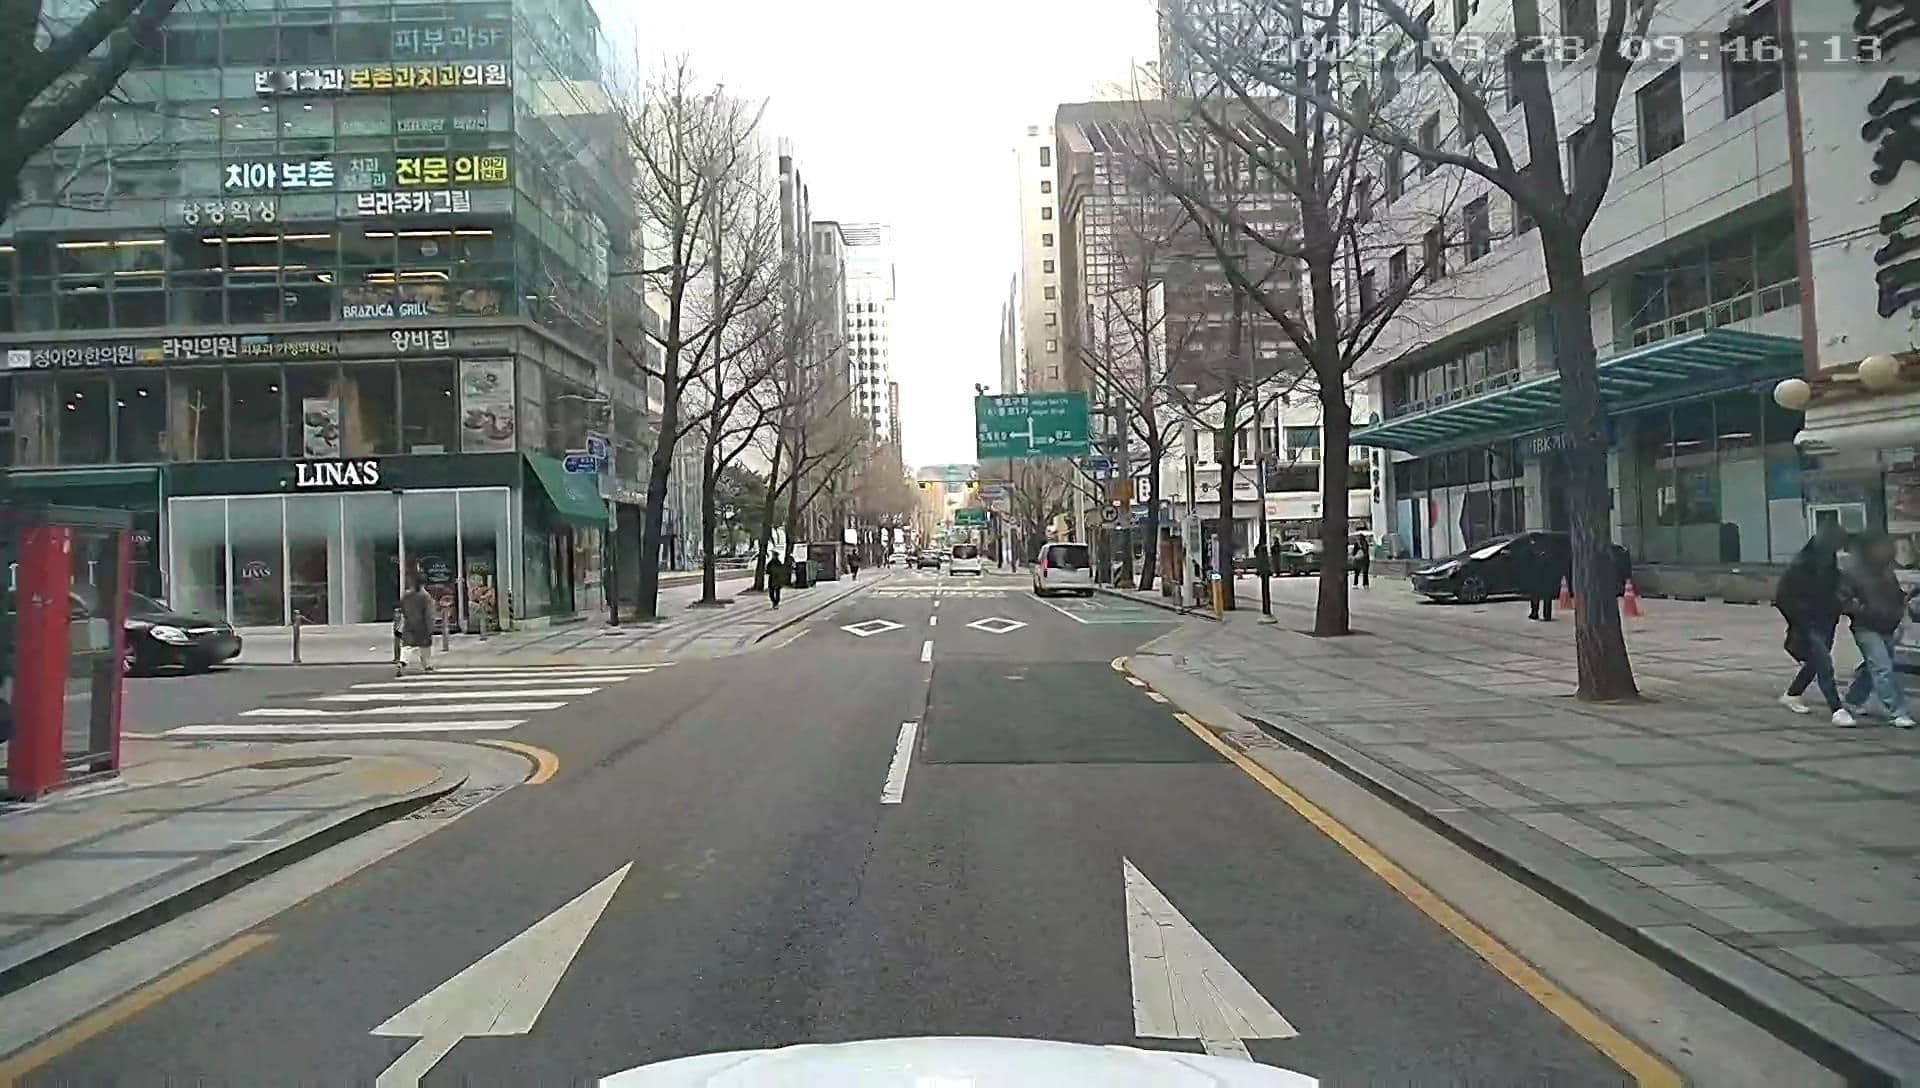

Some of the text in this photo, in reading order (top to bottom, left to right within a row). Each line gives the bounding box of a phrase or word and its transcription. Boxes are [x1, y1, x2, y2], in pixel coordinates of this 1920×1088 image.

[350, 63, 507, 90] 보존과치과의원
[225, 160, 335, 189] 치아 보존
[343, 302, 429, 318] BRAZUCA GRILL
[162, 336, 237, 359] 라민의원
[241, 342, 273, 356] 피부과
[391, 329, 451, 352] 왕비집
[295, 460, 380, 487] LINA'S
